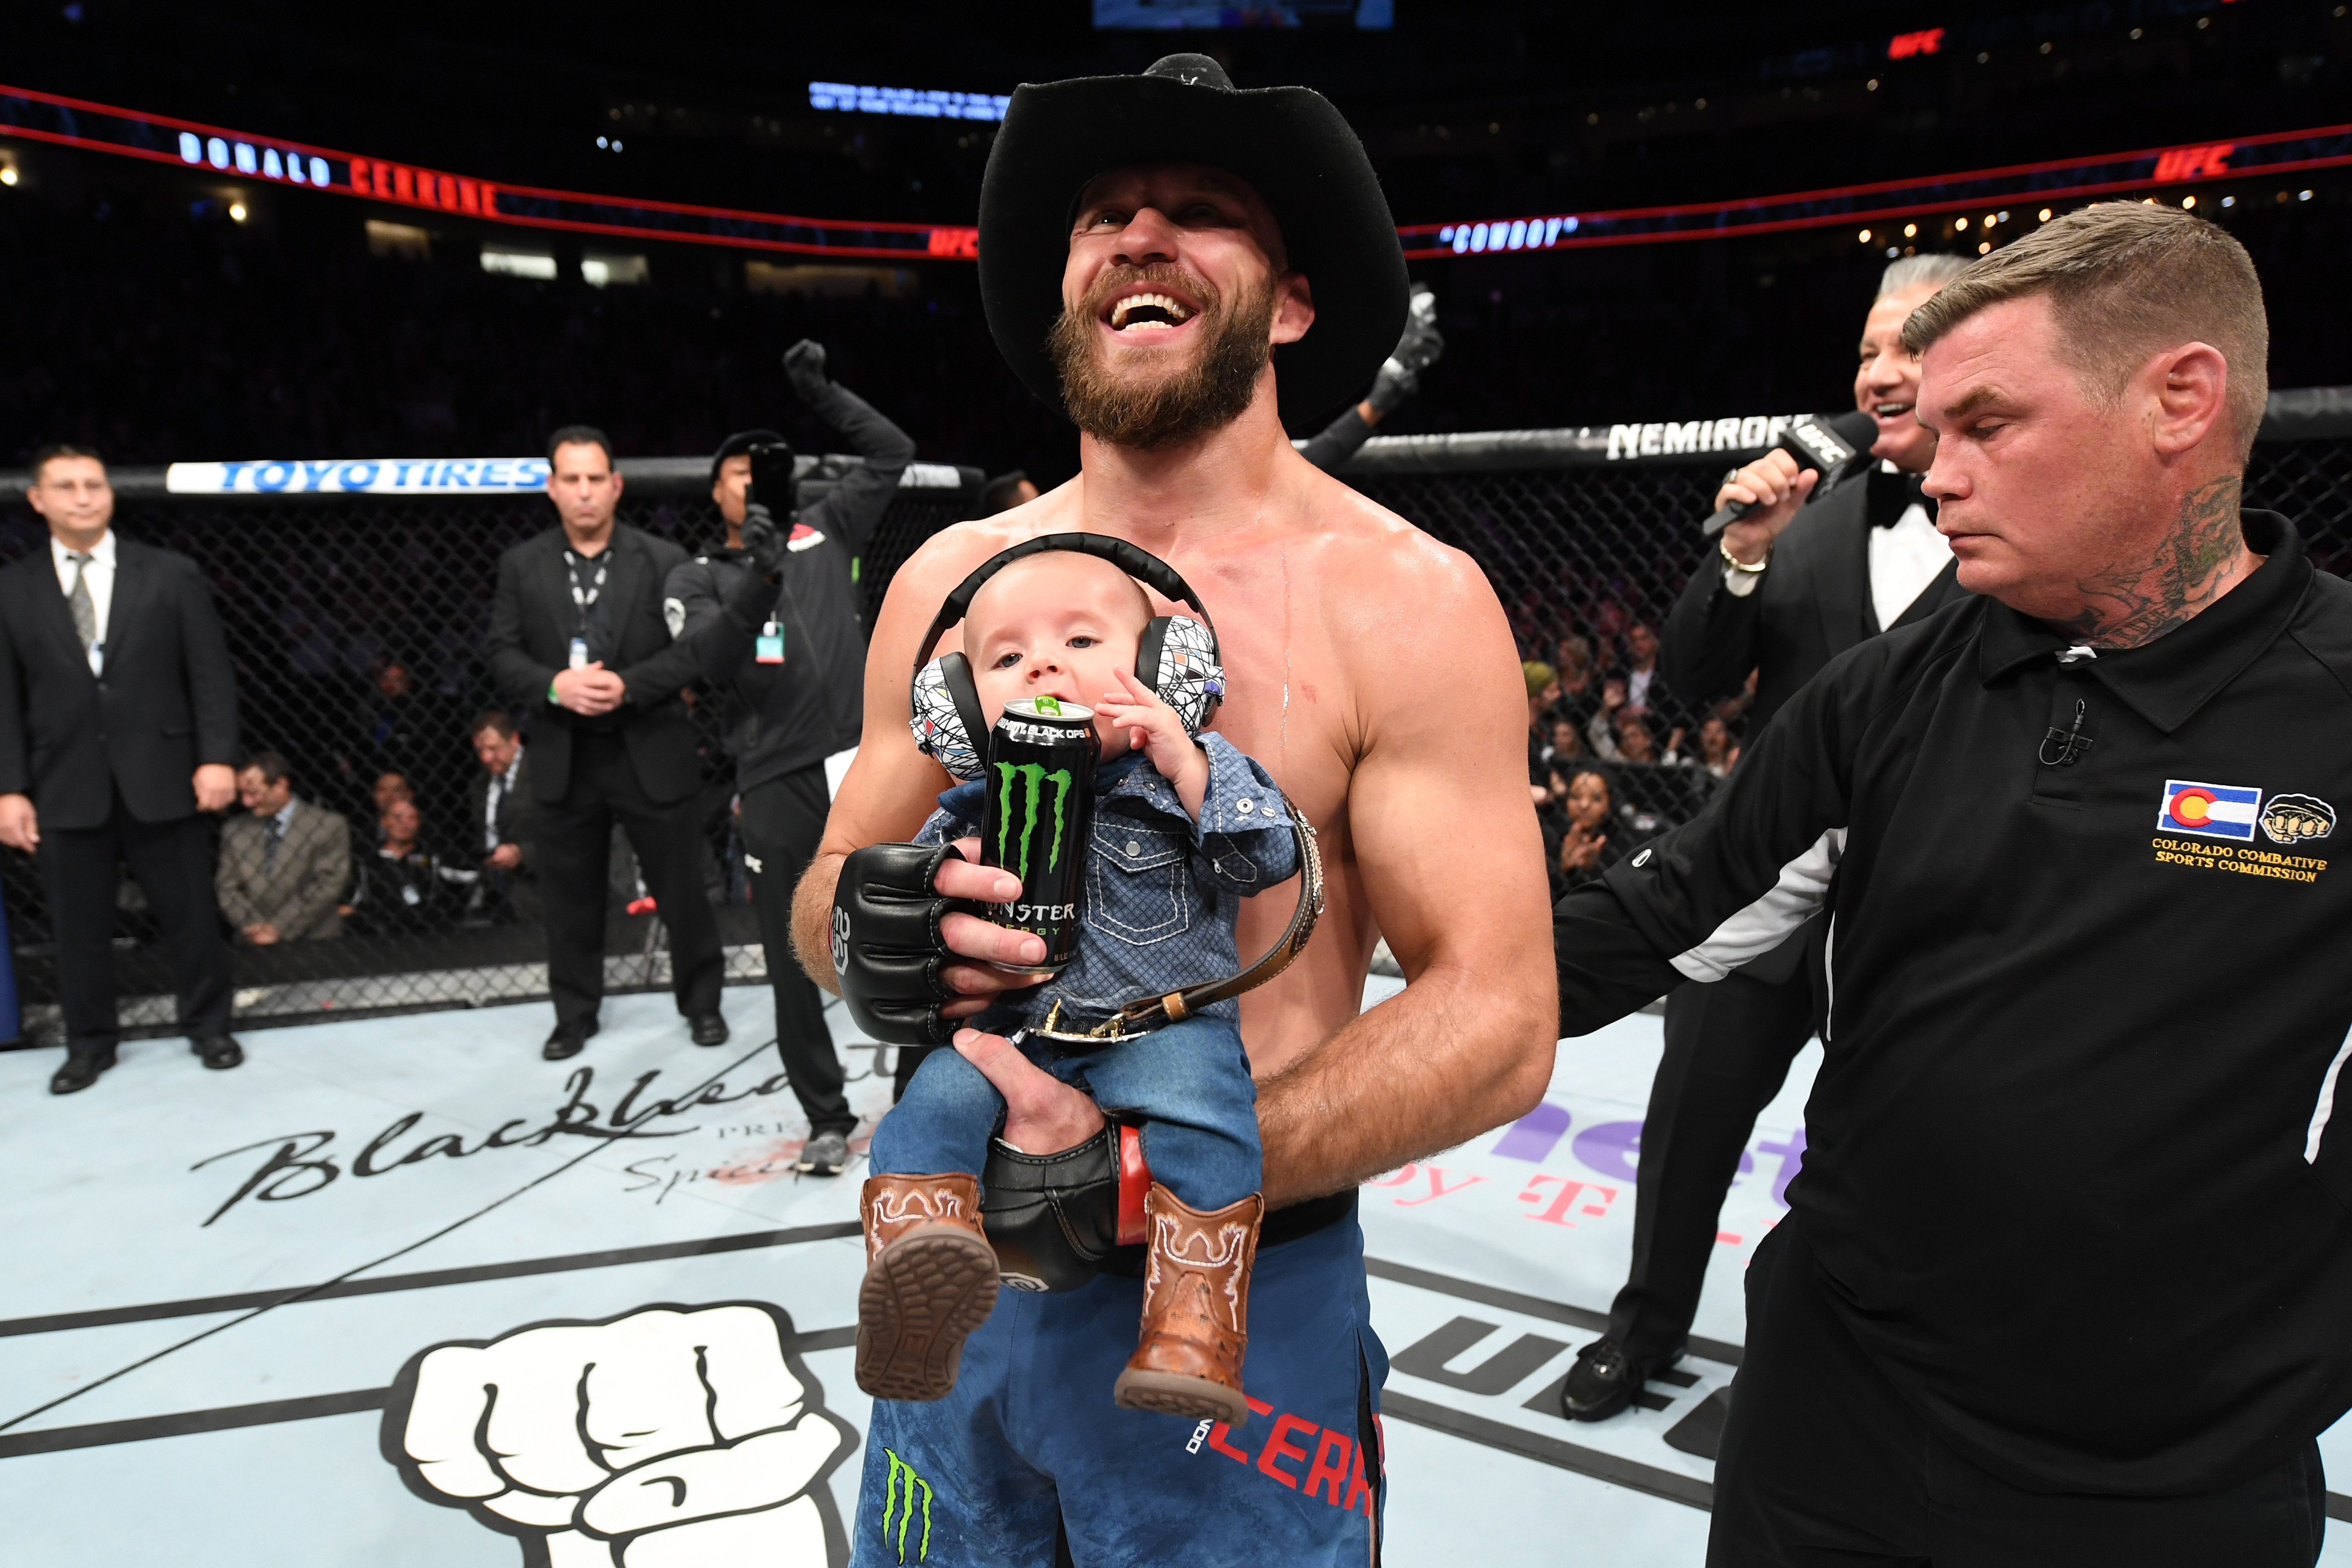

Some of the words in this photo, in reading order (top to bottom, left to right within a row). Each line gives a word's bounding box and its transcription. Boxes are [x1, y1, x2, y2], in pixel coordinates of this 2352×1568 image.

[2154, 144, 2234, 182] UFC
[1796, 423, 1847, 463] UFC
[220, 460, 381, 492] TOYO
[389, 458, 551, 488] TIRES
[1027, 726, 1065, 738] BLACK
[1066, 729, 1086, 739] OPS
[2152, 838, 2233, 857] COLORADO
[2237, 849, 2328, 871] COMBATIVE
[2155, 851, 2215, 868] SPORTS
[2218, 859, 2318, 883] COMMISSION
[972, 899, 1075, 923] ONSTER
[190, 1042, 897, 1227] Blackheat
